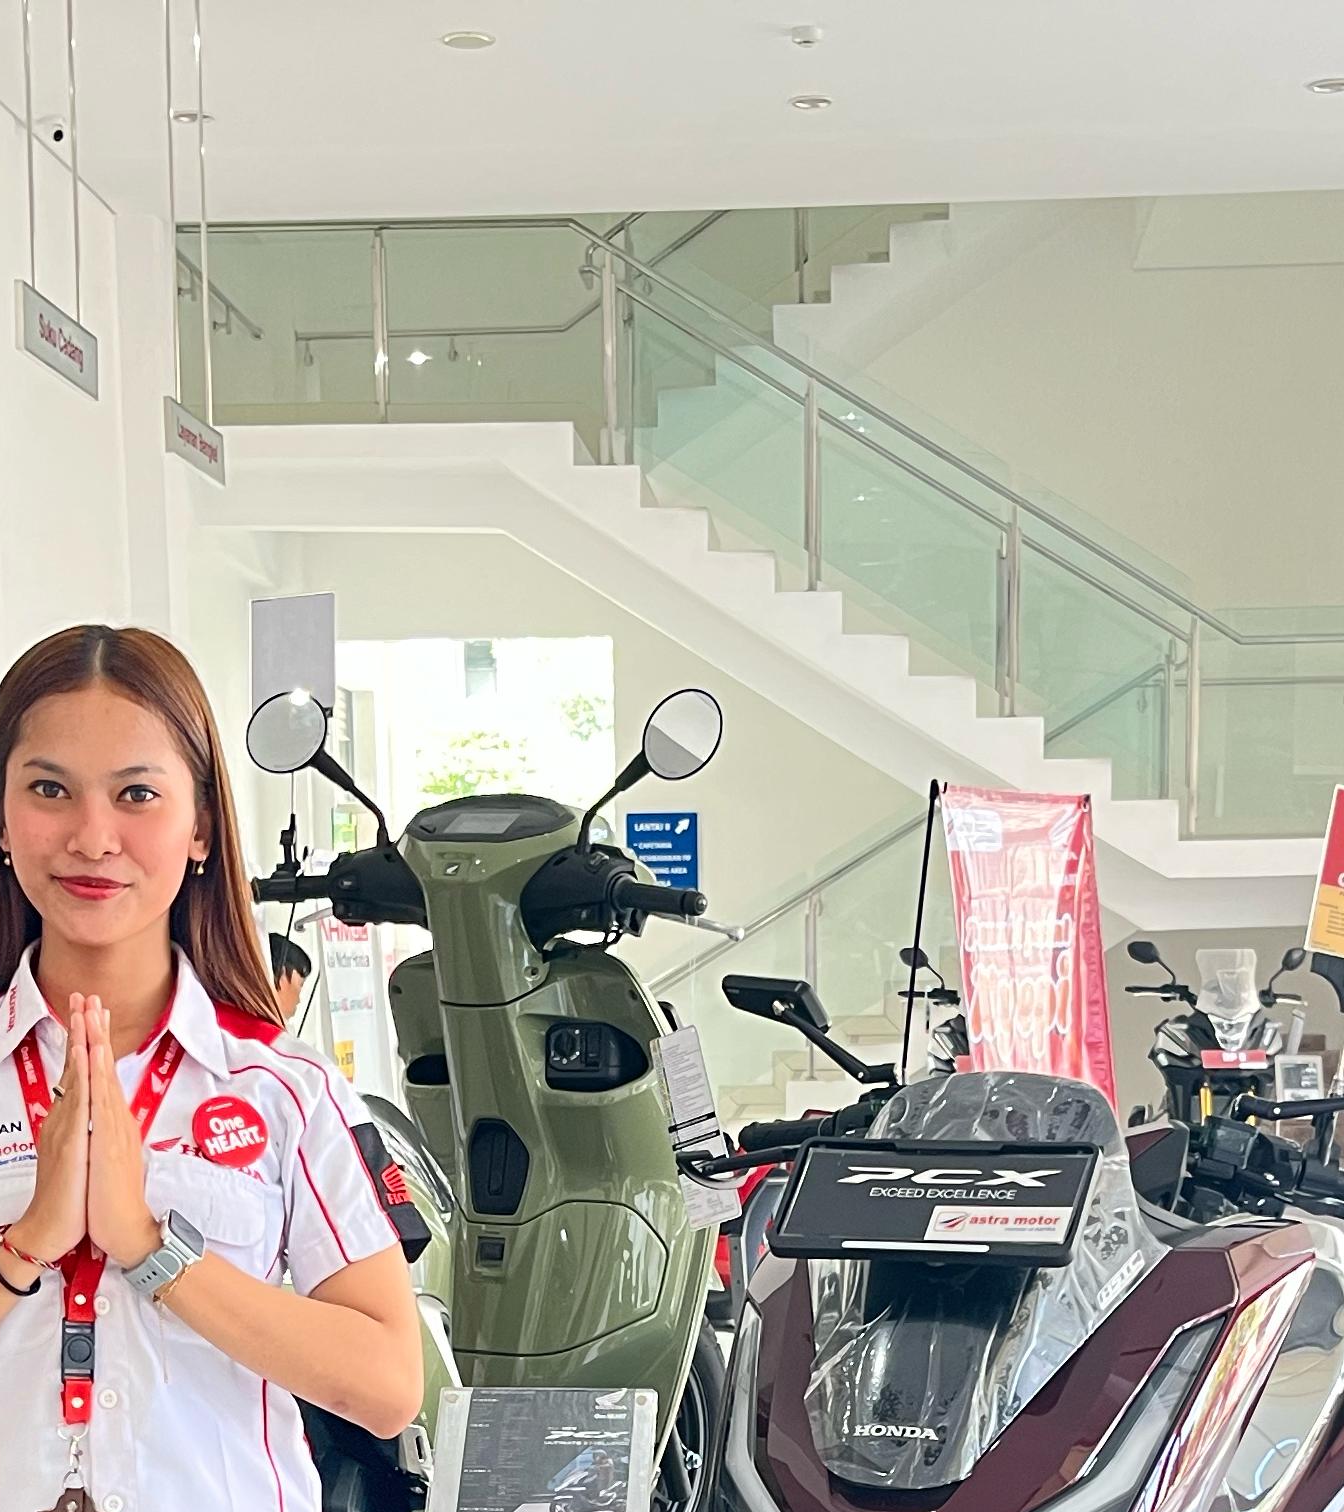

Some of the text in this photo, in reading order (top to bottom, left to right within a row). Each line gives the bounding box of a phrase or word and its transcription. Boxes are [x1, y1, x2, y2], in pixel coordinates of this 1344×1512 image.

[205, 1116, 265, 1157] One HEART.
[837, 1166, 1062, 1188] PCX
[869, 1186, 1018, 1200] EXCEED EXCELLENCE
[969, 1214, 1061, 1226] astra motor
[853, 1424, 940, 1441] HONDA
